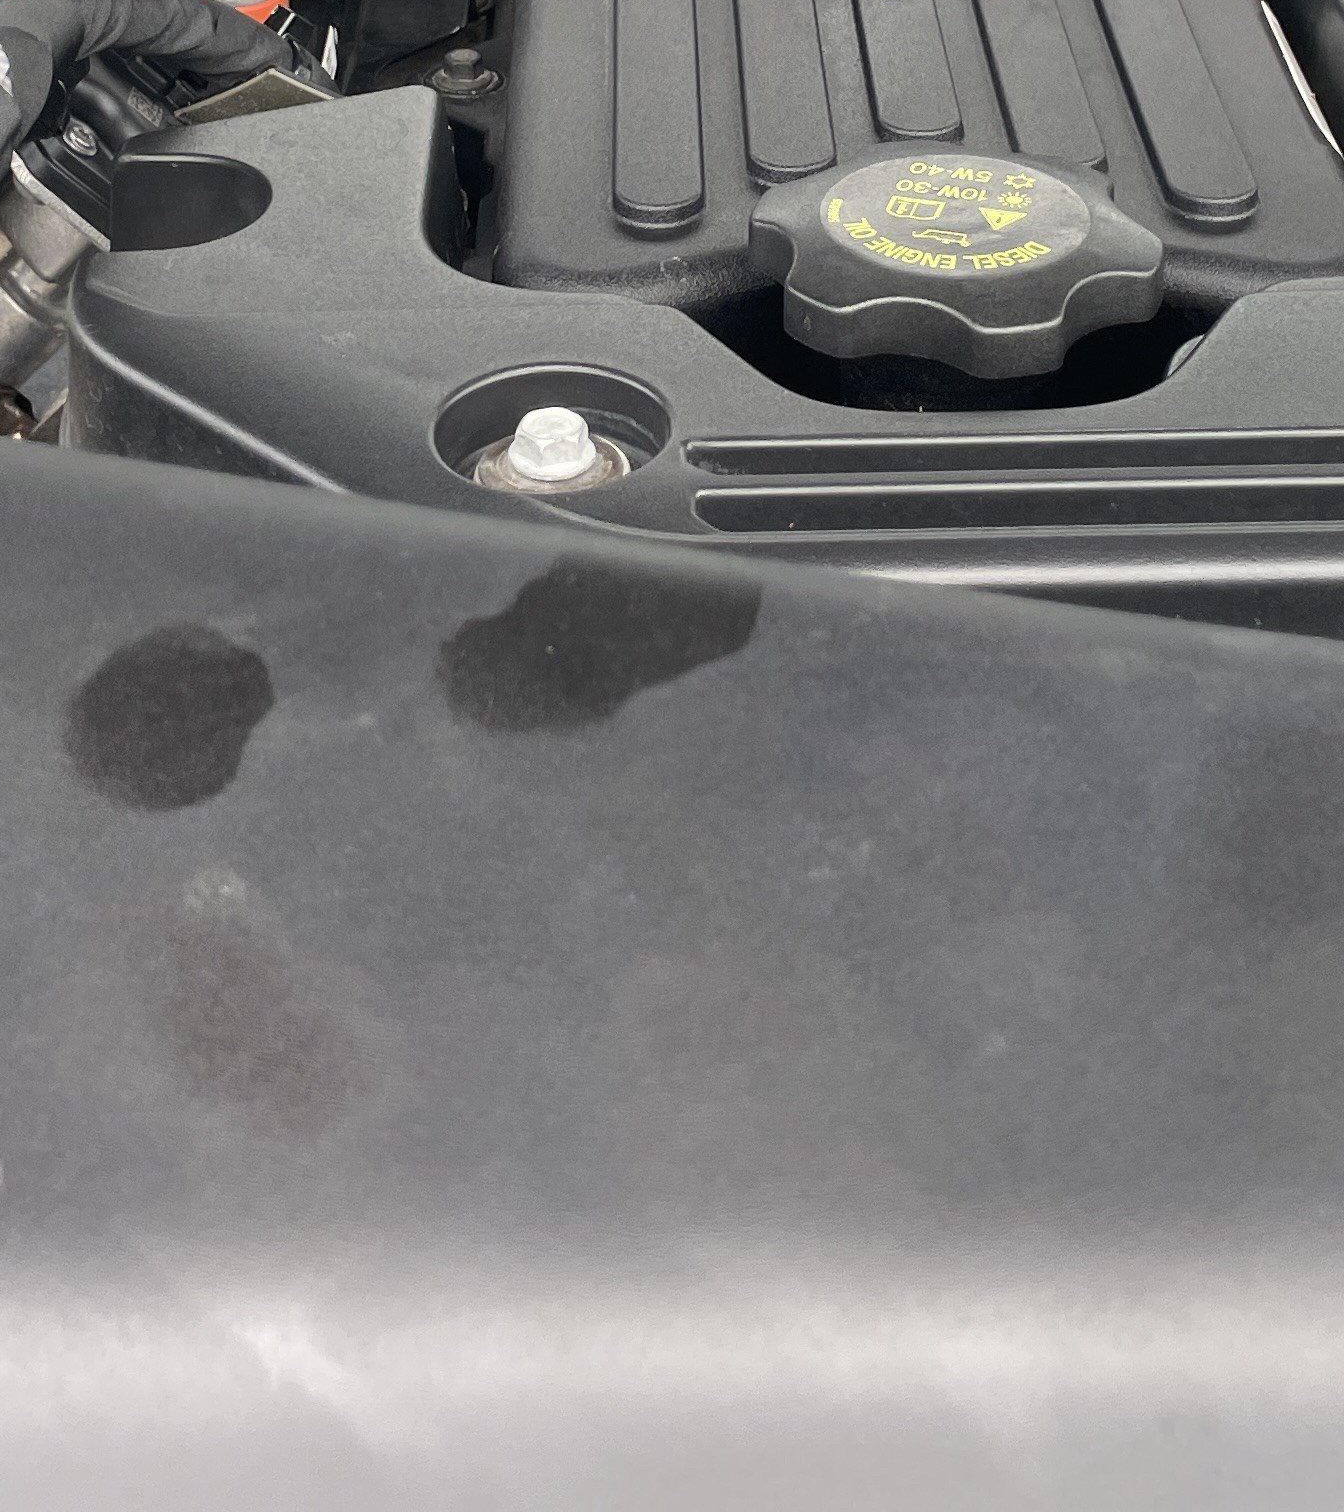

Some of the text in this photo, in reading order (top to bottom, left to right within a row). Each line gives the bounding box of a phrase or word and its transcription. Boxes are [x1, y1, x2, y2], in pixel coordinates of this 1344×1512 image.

[909, 161, 994, 183] 5W-40
[895, 179, 988, 203] 10W-30
[842, 216, 1052, 270] DIESEL ENGINE OIL
